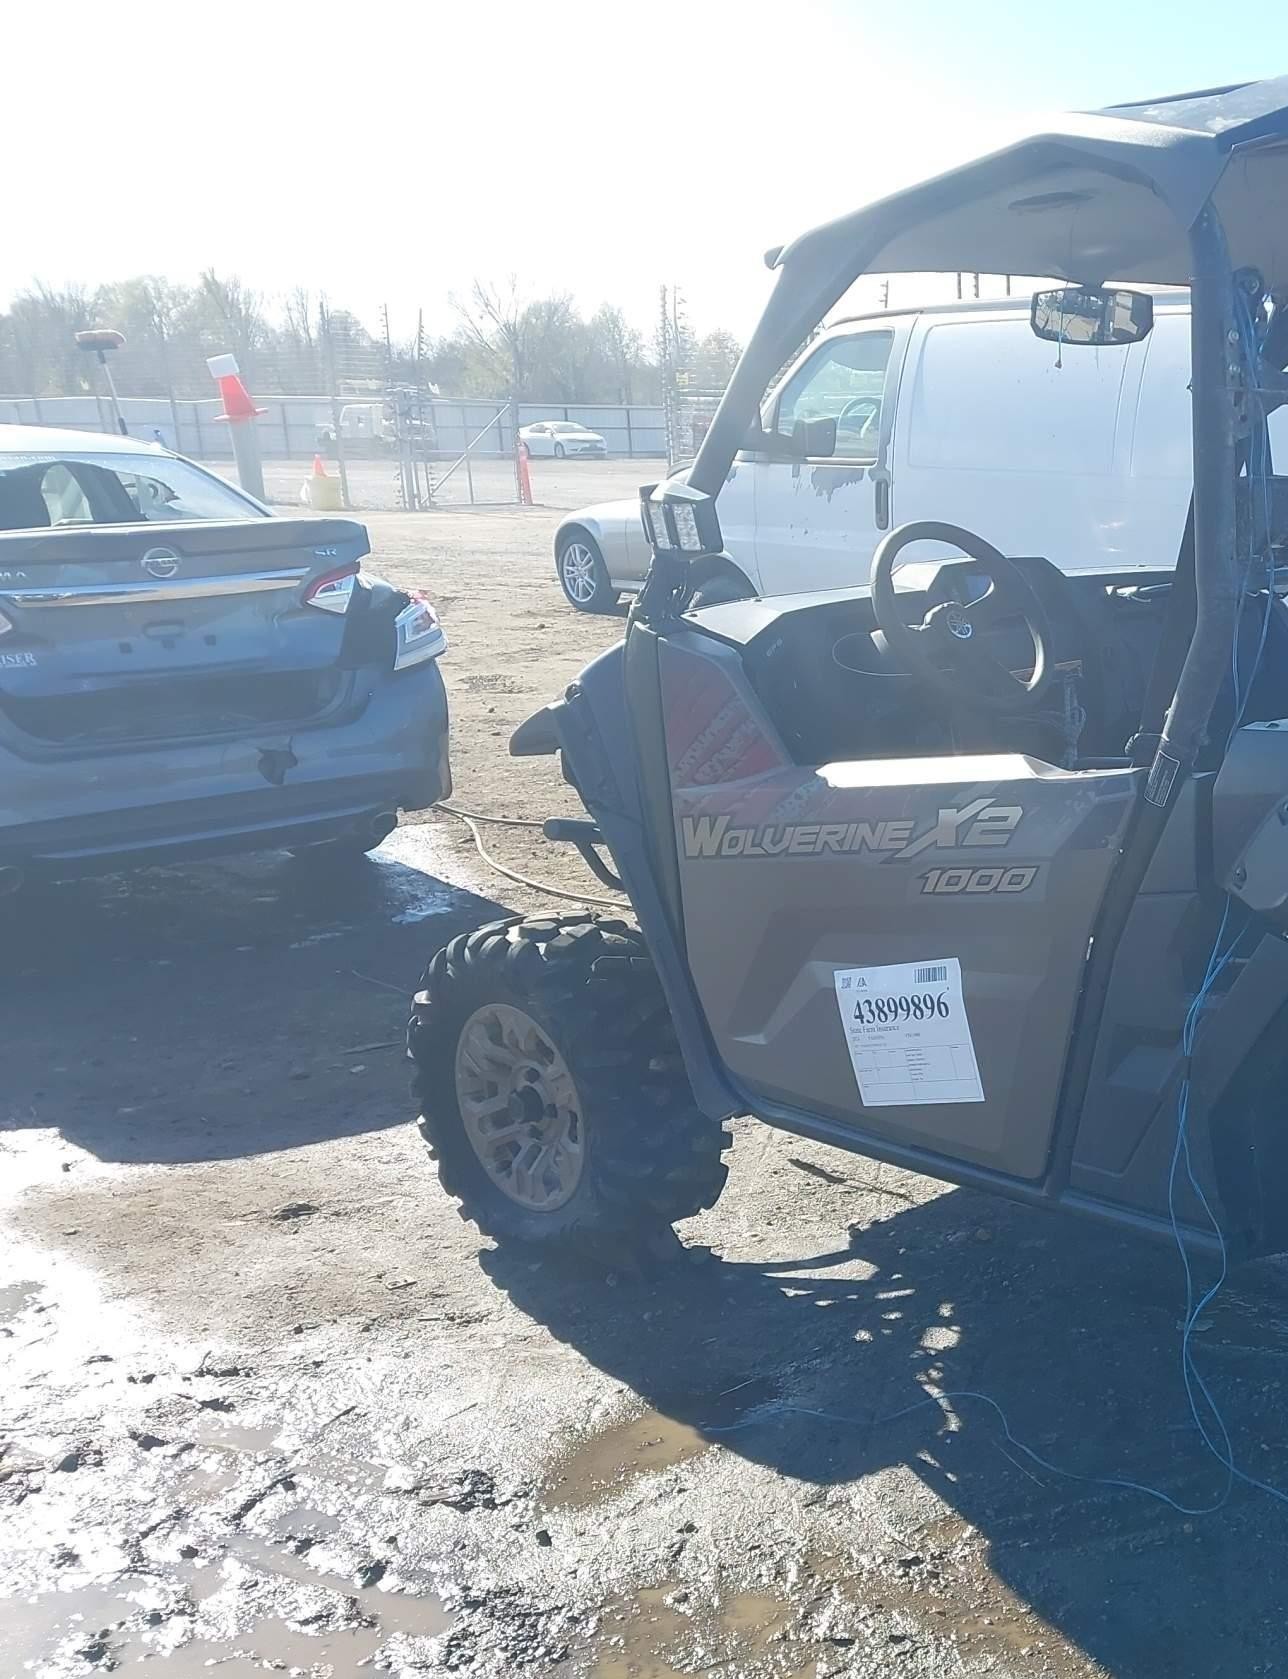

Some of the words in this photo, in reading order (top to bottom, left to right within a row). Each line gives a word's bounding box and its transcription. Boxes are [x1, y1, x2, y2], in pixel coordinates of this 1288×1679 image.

[682, 814, 915, 858] WOLVERINE
[893, 797, 1024, 859] X2
[920, 866, 1040, 894] 1000
[854, 991, 950, 1024] 43899896
